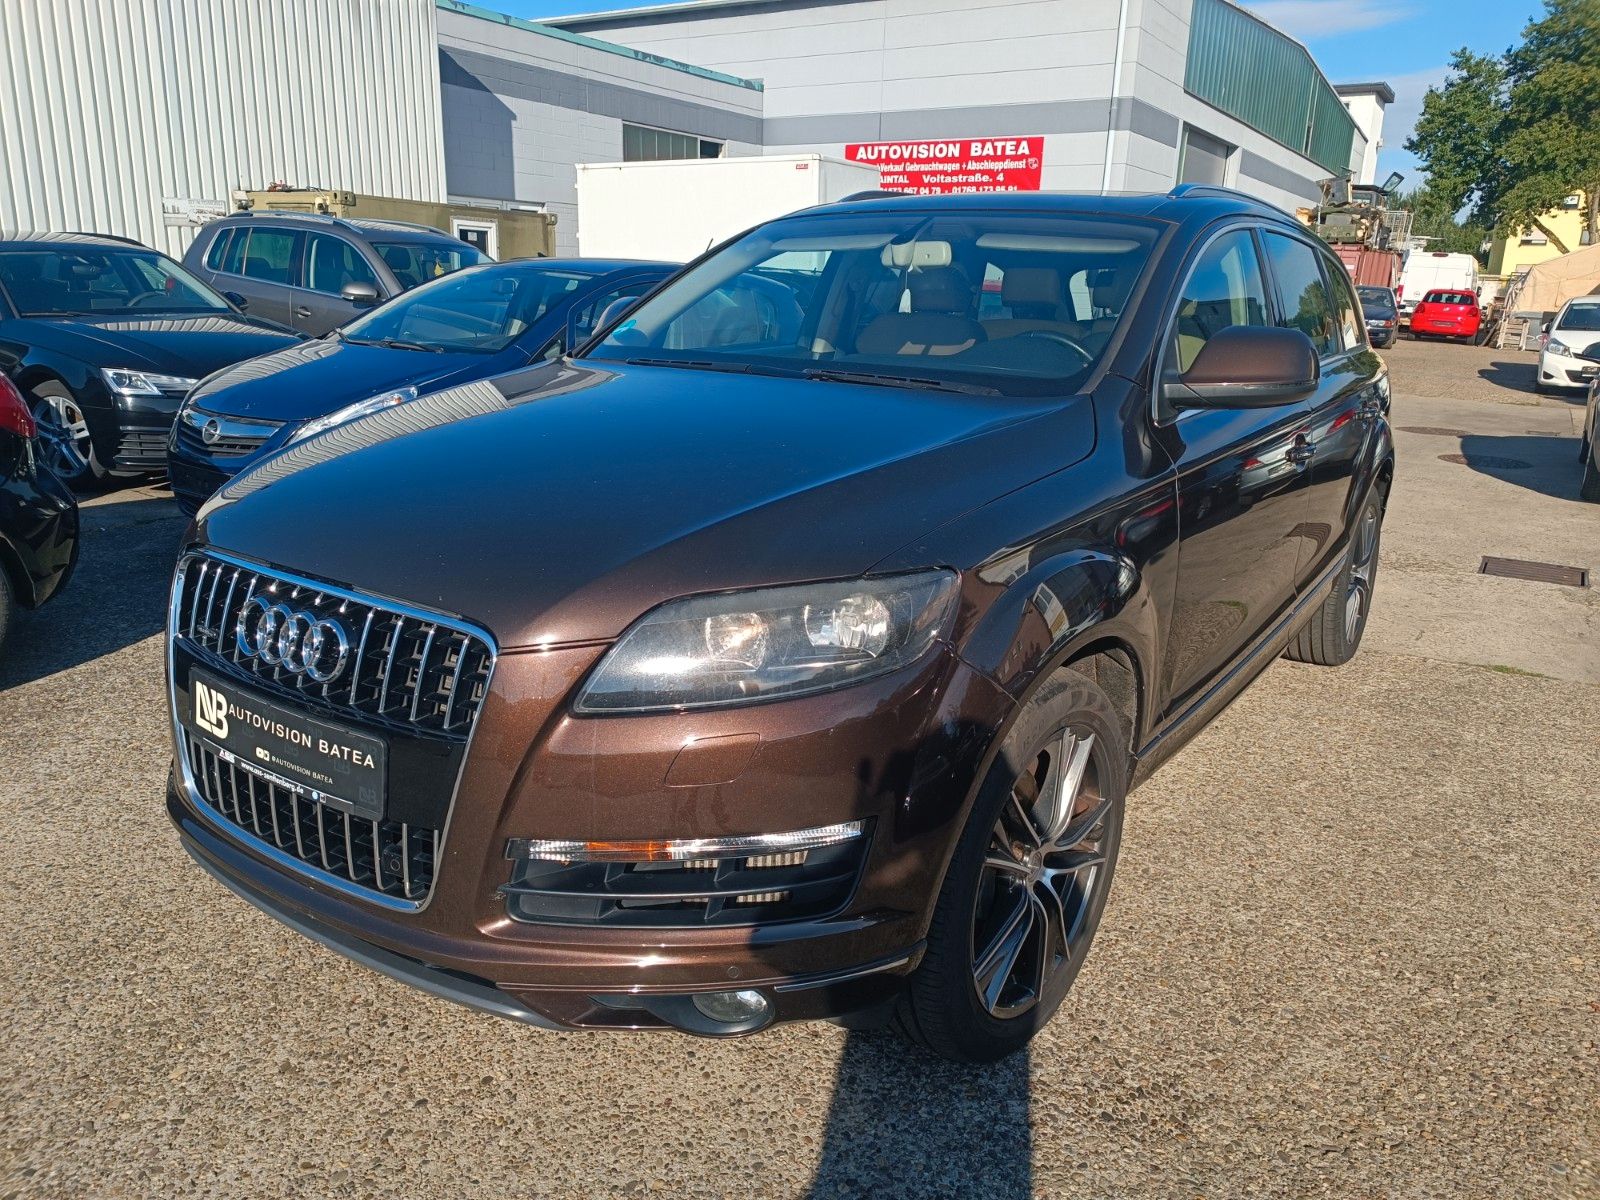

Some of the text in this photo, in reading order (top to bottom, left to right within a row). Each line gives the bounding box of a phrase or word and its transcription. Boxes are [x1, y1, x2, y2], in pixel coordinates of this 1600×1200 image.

[856, 141, 1030, 160] AUTOVISION BATEA
[905, 161, 960, 172] Gebrauchtwagen
[996, 173, 1004, 182] 4
[228, 703, 375, 769] AUTOVISION BATEA
[312, 771, 333, 784] BATEA
